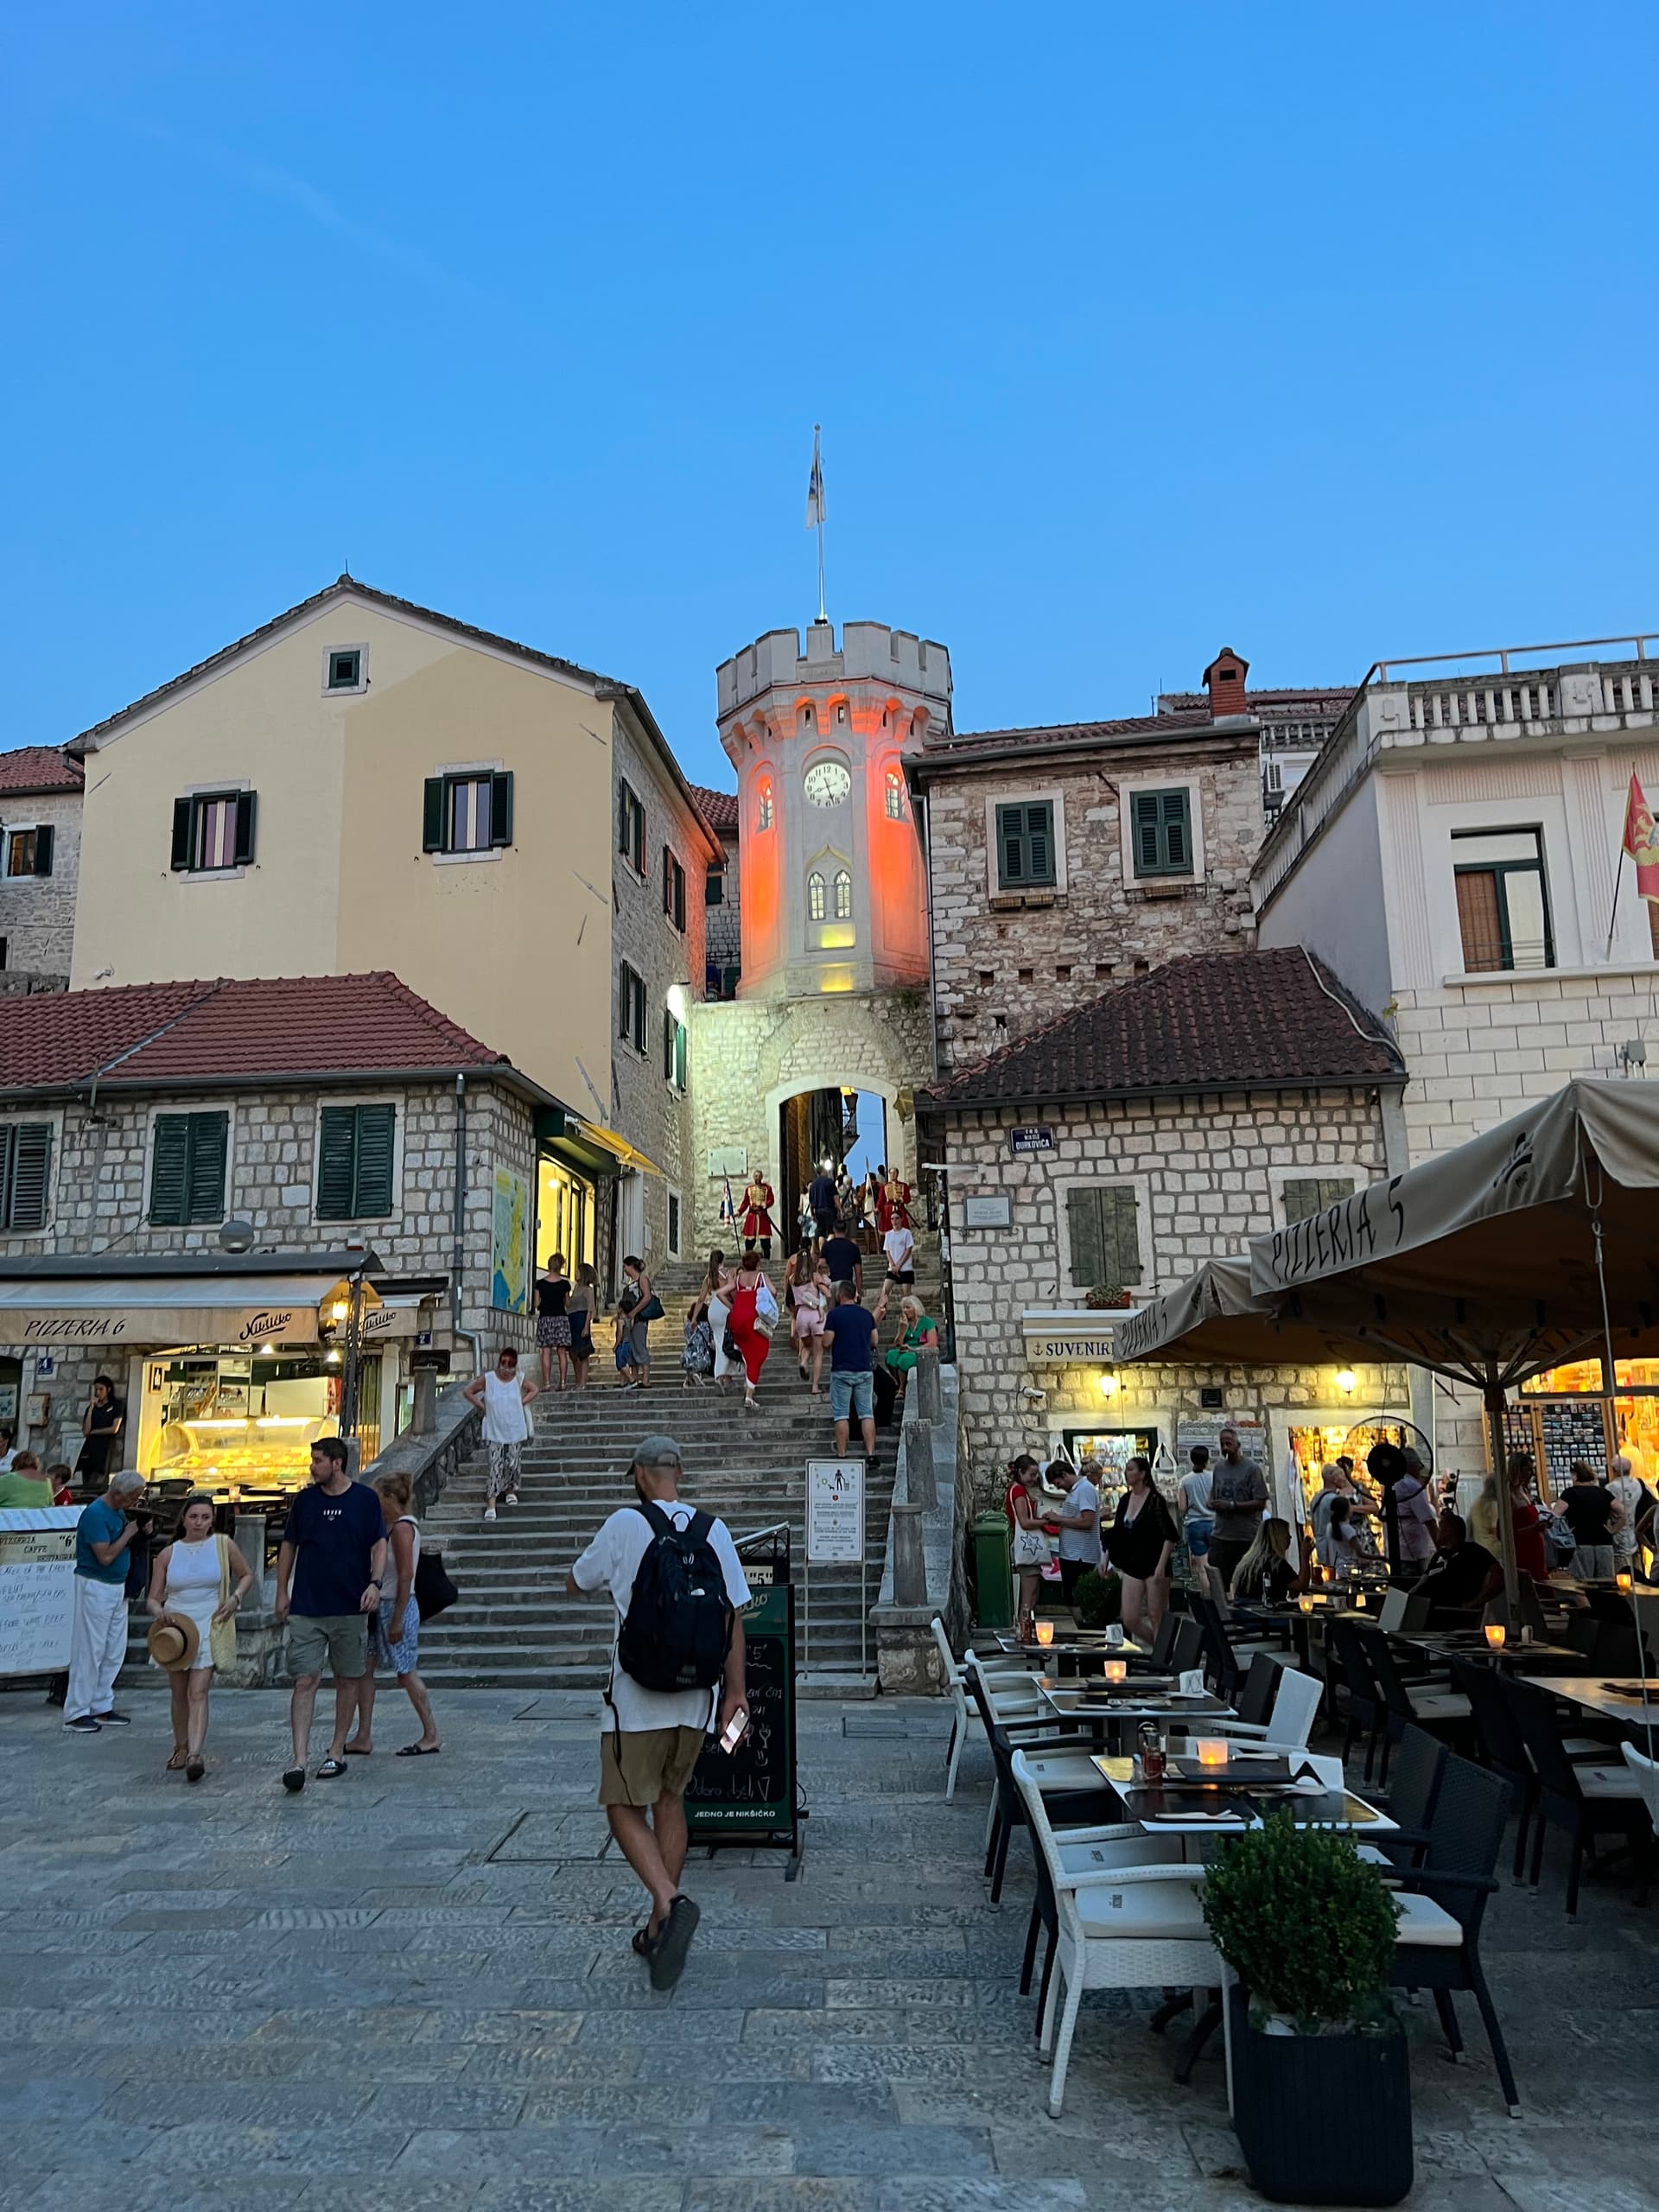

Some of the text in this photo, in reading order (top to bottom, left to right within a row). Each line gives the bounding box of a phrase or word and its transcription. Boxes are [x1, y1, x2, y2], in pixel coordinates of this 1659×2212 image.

[1271, 1173, 1405, 1285] PIZZERIA 5
[24, 1319, 127, 1338] PIZZERIA 6
